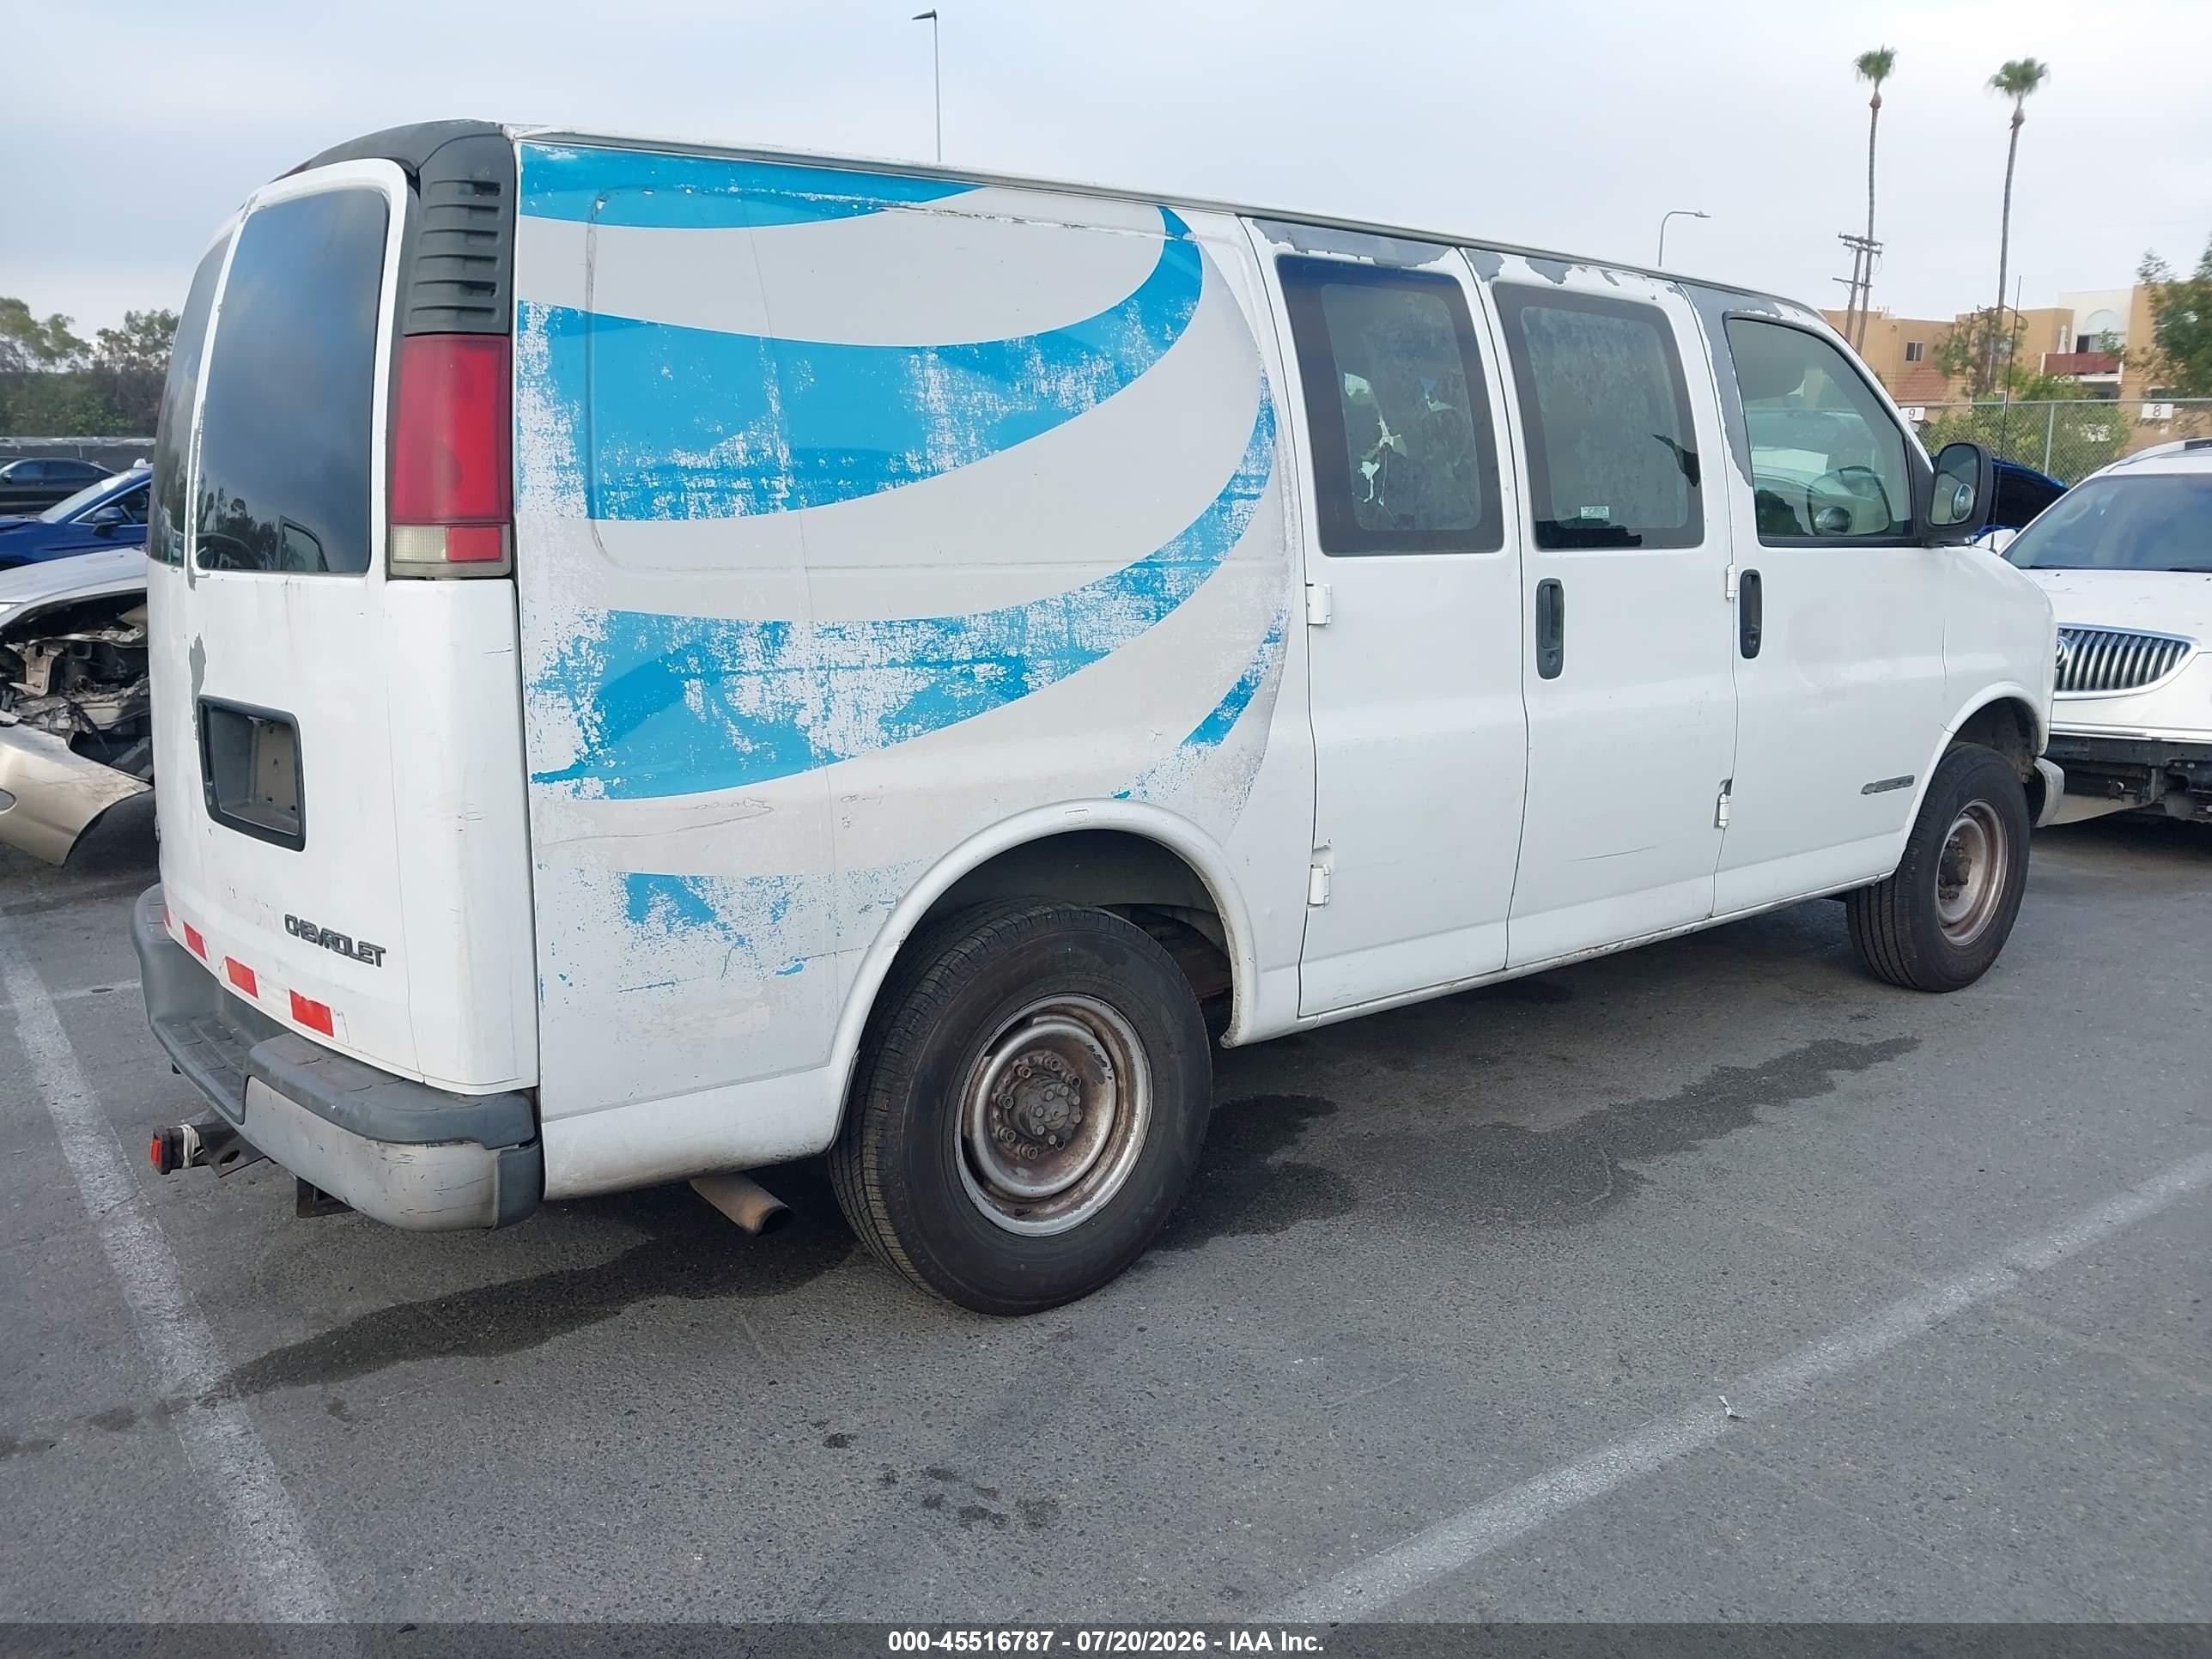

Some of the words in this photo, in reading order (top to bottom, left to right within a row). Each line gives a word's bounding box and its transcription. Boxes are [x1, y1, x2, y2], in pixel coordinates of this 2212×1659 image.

[1908, 408, 1916, 420] 9
[2152, 404, 2162, 417] 8
[284, 914, 386, 968] CHEVROLET
